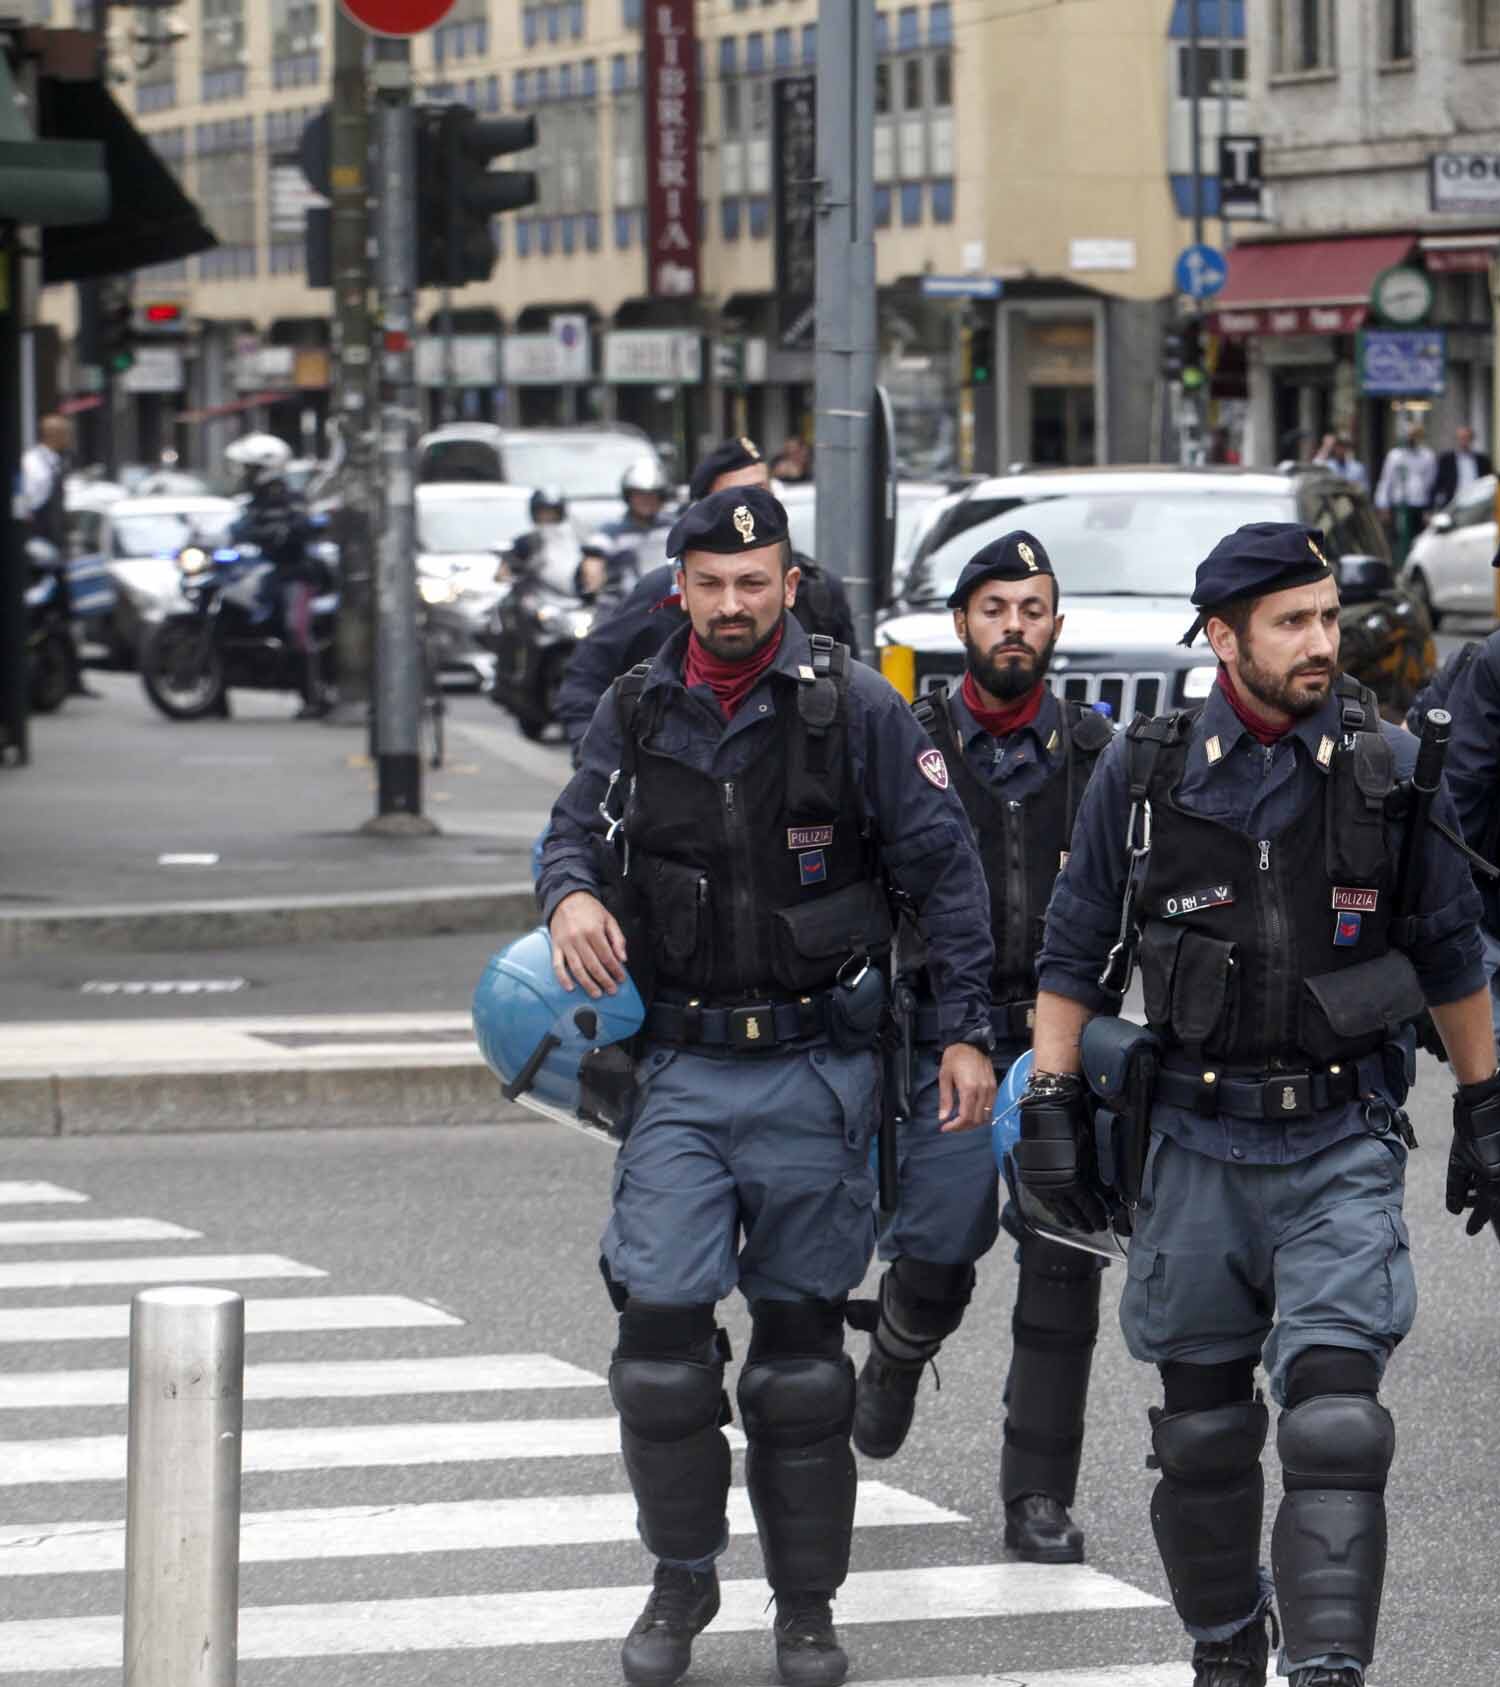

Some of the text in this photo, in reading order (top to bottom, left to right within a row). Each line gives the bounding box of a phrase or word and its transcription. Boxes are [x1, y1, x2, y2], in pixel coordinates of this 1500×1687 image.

[656, 4, 690, 250] LIBRERIA
[791, 829, 831, 845] POLIZIA
[1182, 895, 1198, 910] RH
[1335, 891, 1373, 906] POLIZIA
